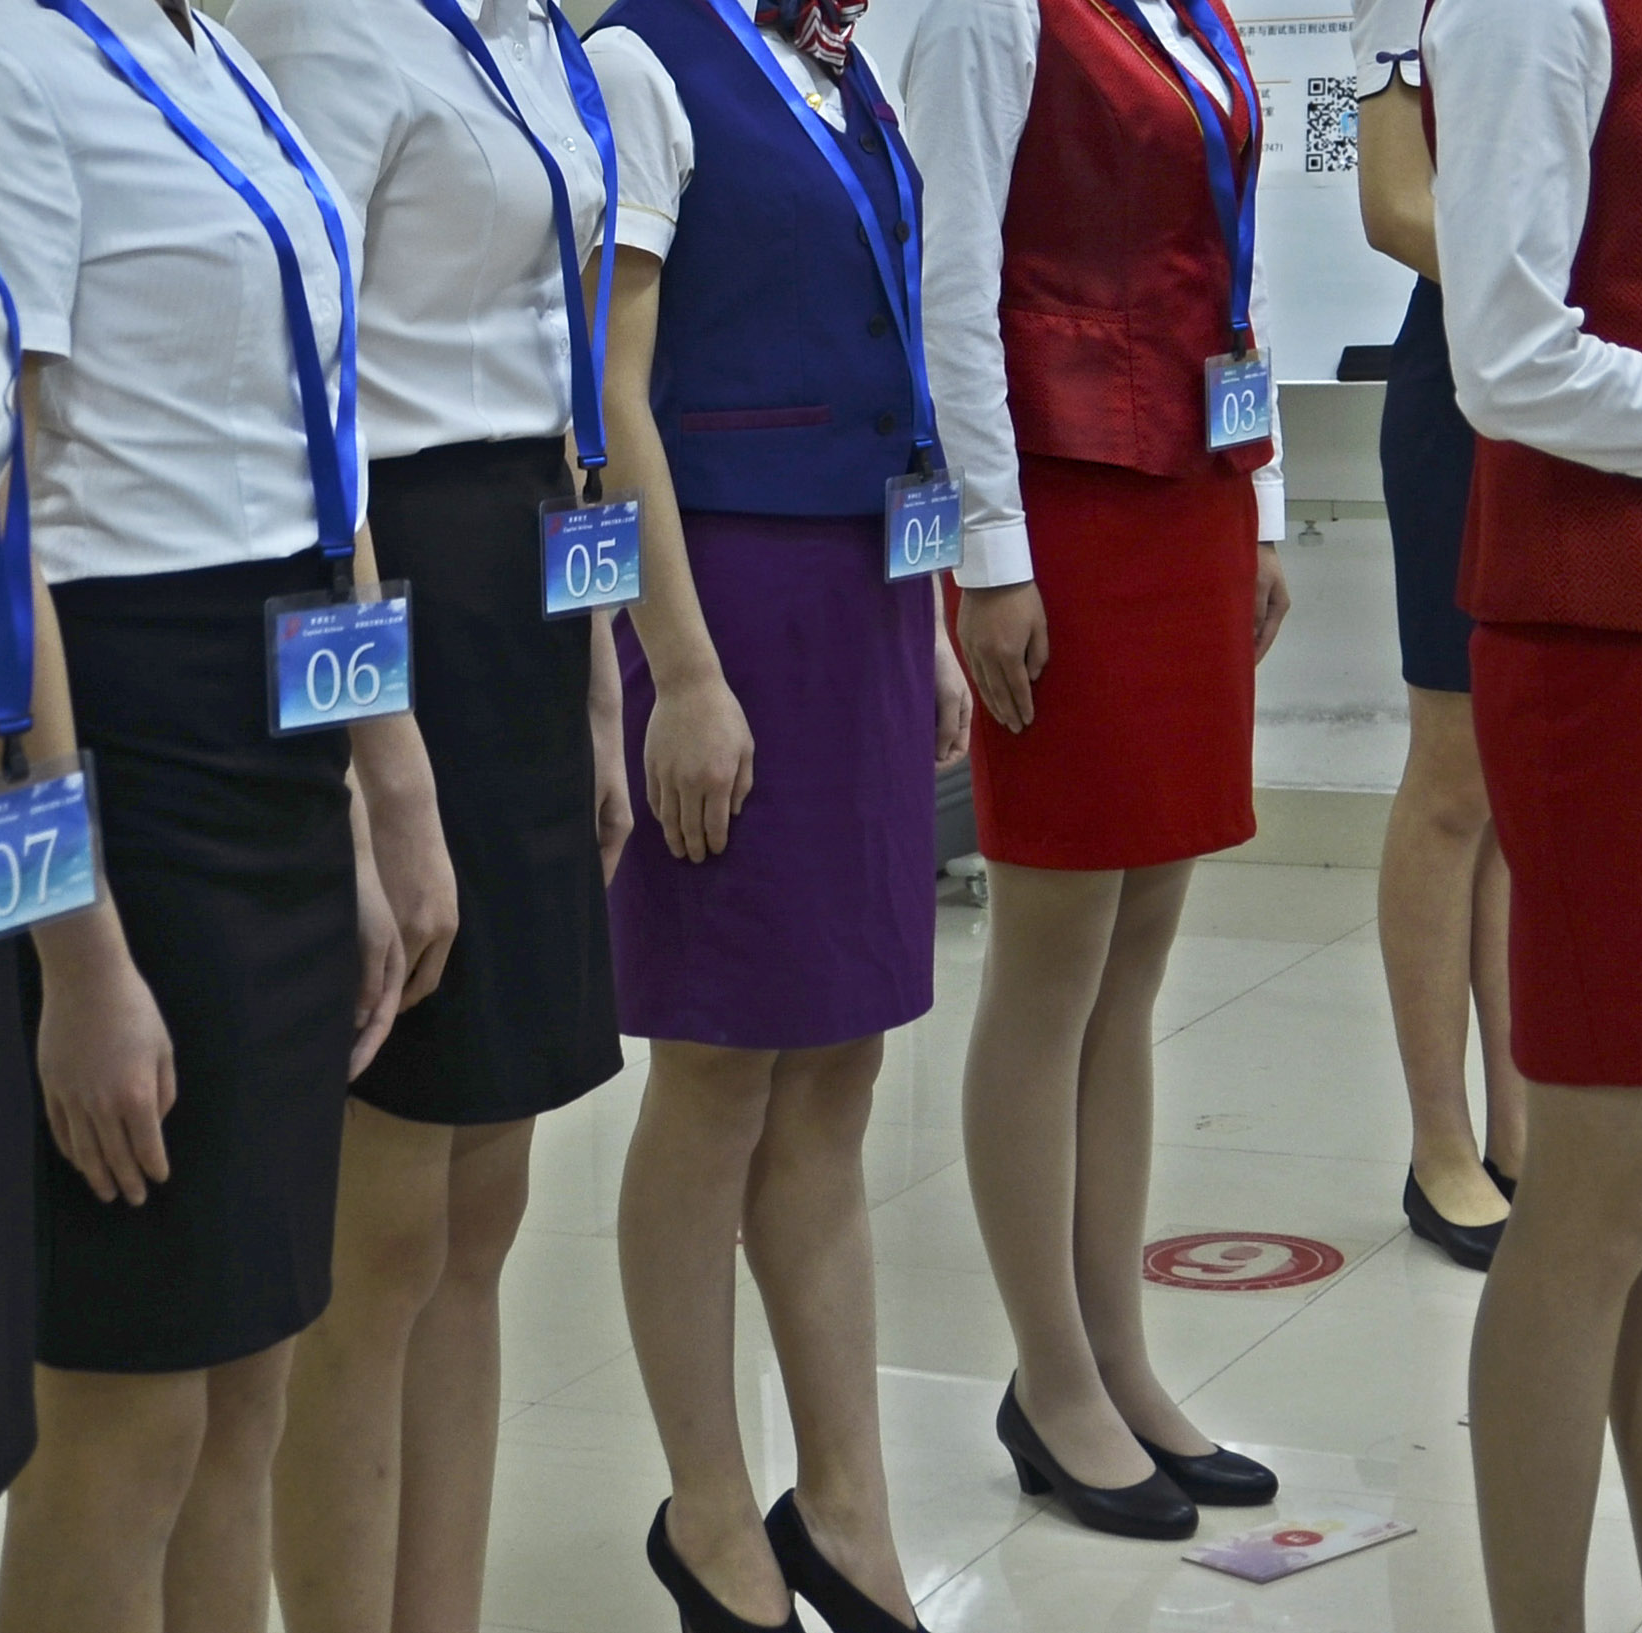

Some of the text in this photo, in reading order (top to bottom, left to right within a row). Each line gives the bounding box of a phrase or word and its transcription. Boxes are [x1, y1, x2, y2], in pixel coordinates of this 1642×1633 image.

[1223, 389, 1256, 435] 03
[565, 537, 618, 598] 05
[904, 515, 944, 565] 04
[307, 641, 380, 711] 06
